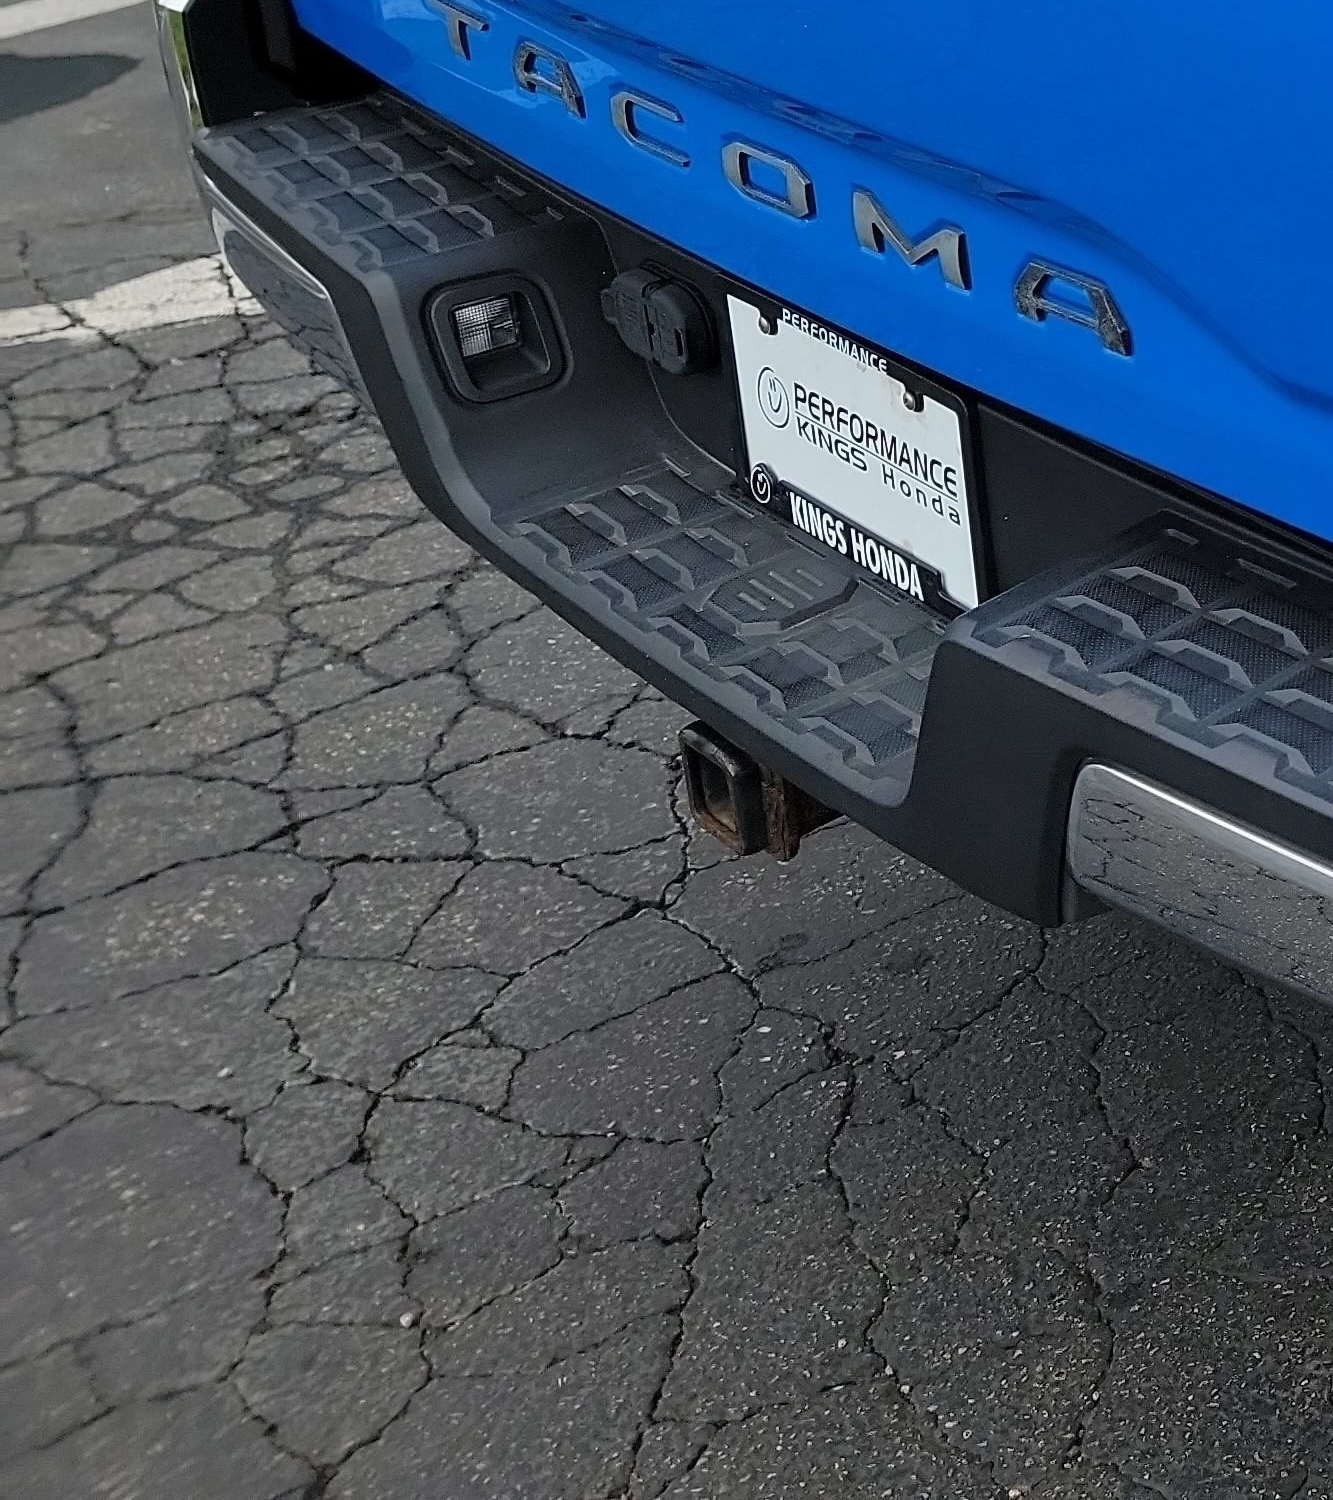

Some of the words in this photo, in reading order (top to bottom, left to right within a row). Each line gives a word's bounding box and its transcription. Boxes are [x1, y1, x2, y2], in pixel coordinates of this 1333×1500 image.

[782, 307, 889, 374] PERFORMANCE
[793, 381, 959, 499] PERFORMANCE
[796, 415, 868, 473] KINGS
[882, 467, 962, 527] Honda
[789, 490, 849, 556] KINGS
[850, 526, 925, 602] HONDA
